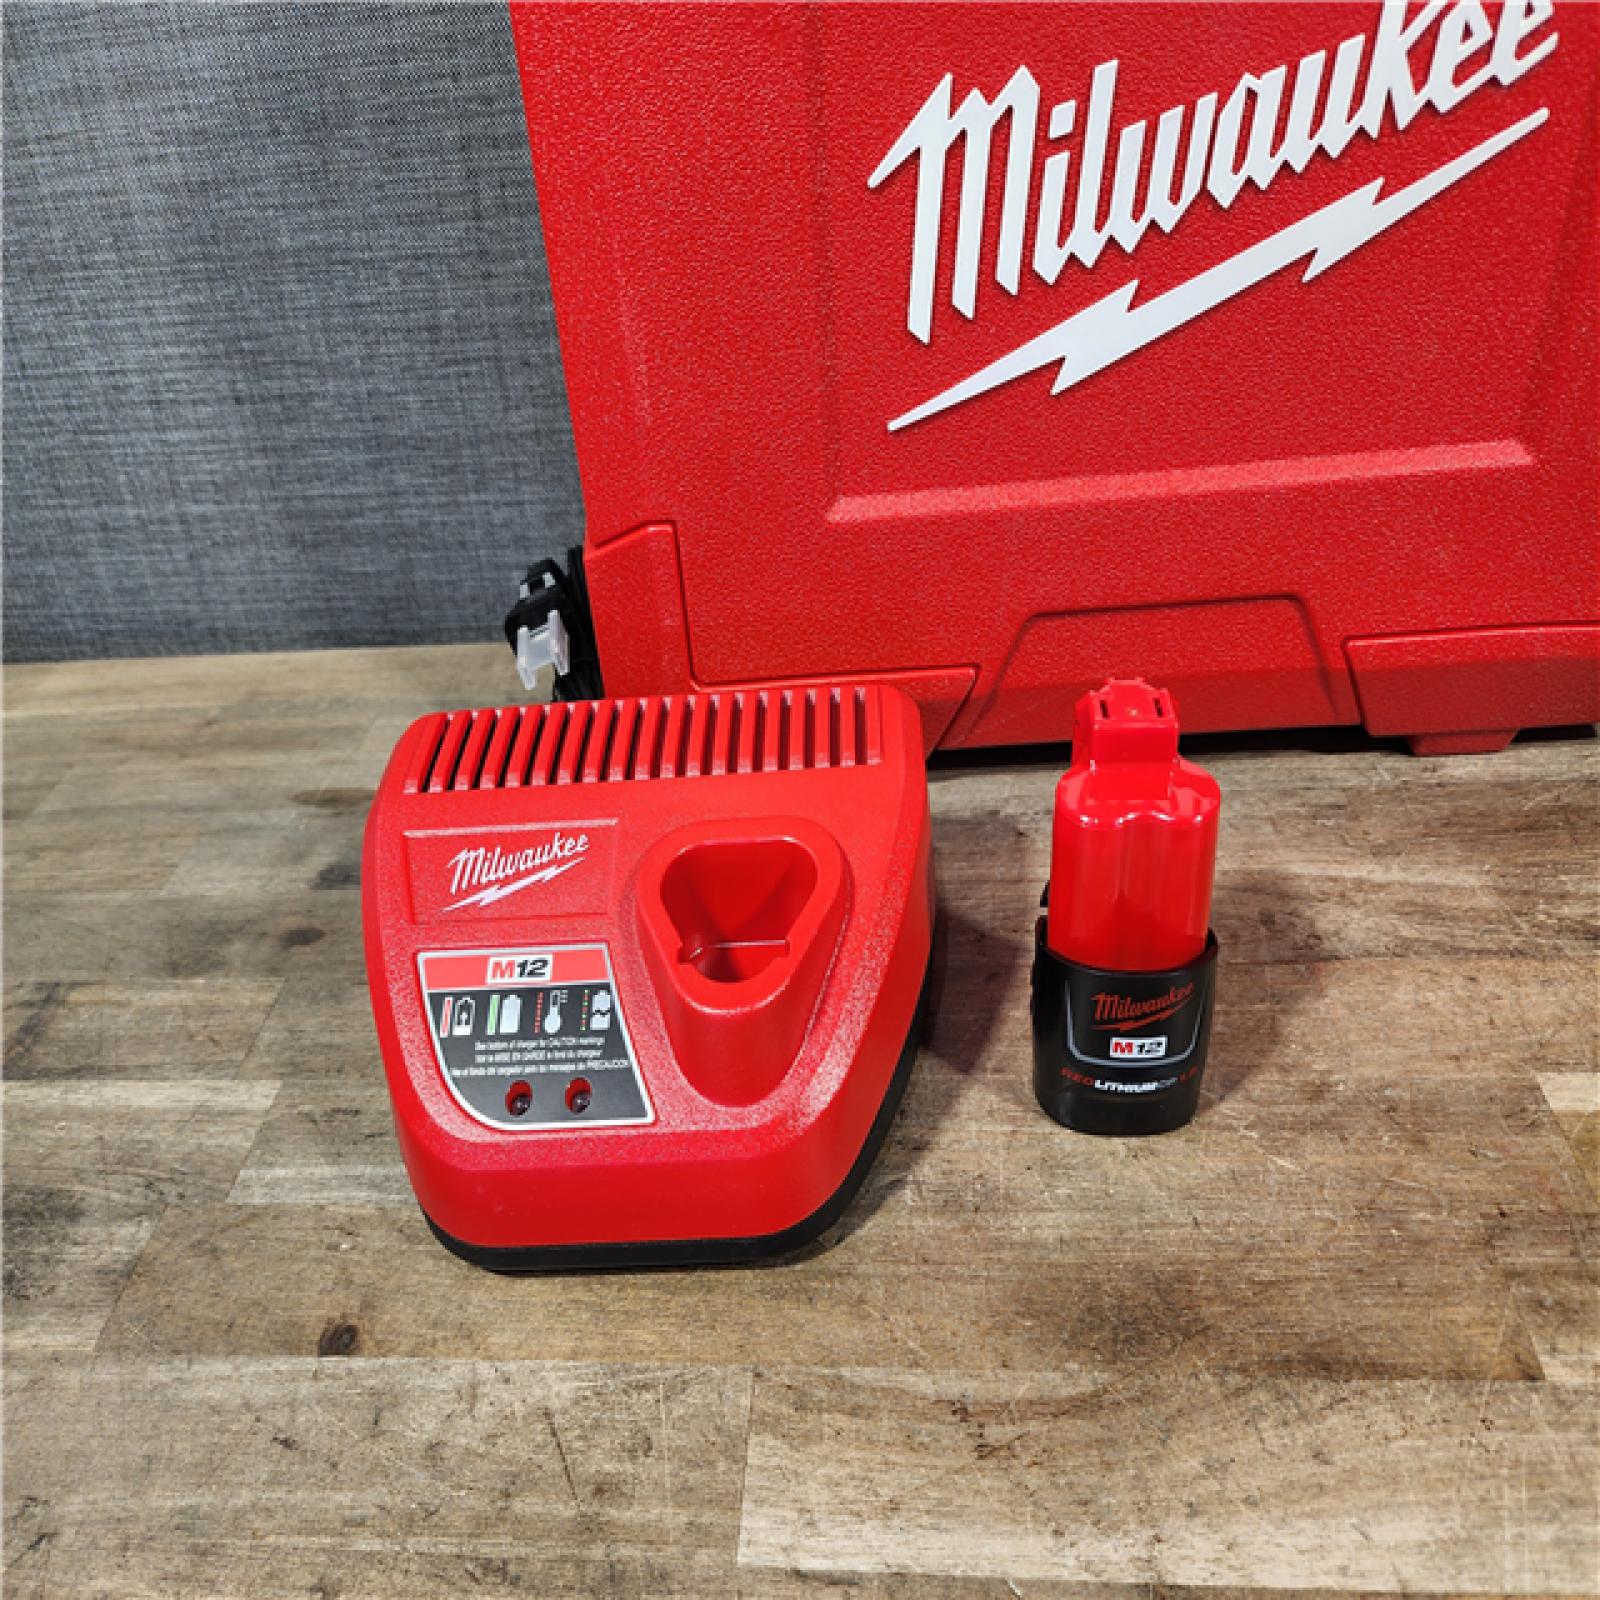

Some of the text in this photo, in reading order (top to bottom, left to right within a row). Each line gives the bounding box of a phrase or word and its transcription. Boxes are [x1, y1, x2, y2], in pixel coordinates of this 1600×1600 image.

[867, 0, 1559, 345] Milwaukee
[447, 832, 589, 894] Milwaukee
[491, 958, 549, 979] M12
[1091, 982, 1194, 1021] Milwaukee
[1112, 1040, 1164, 1055] M12
